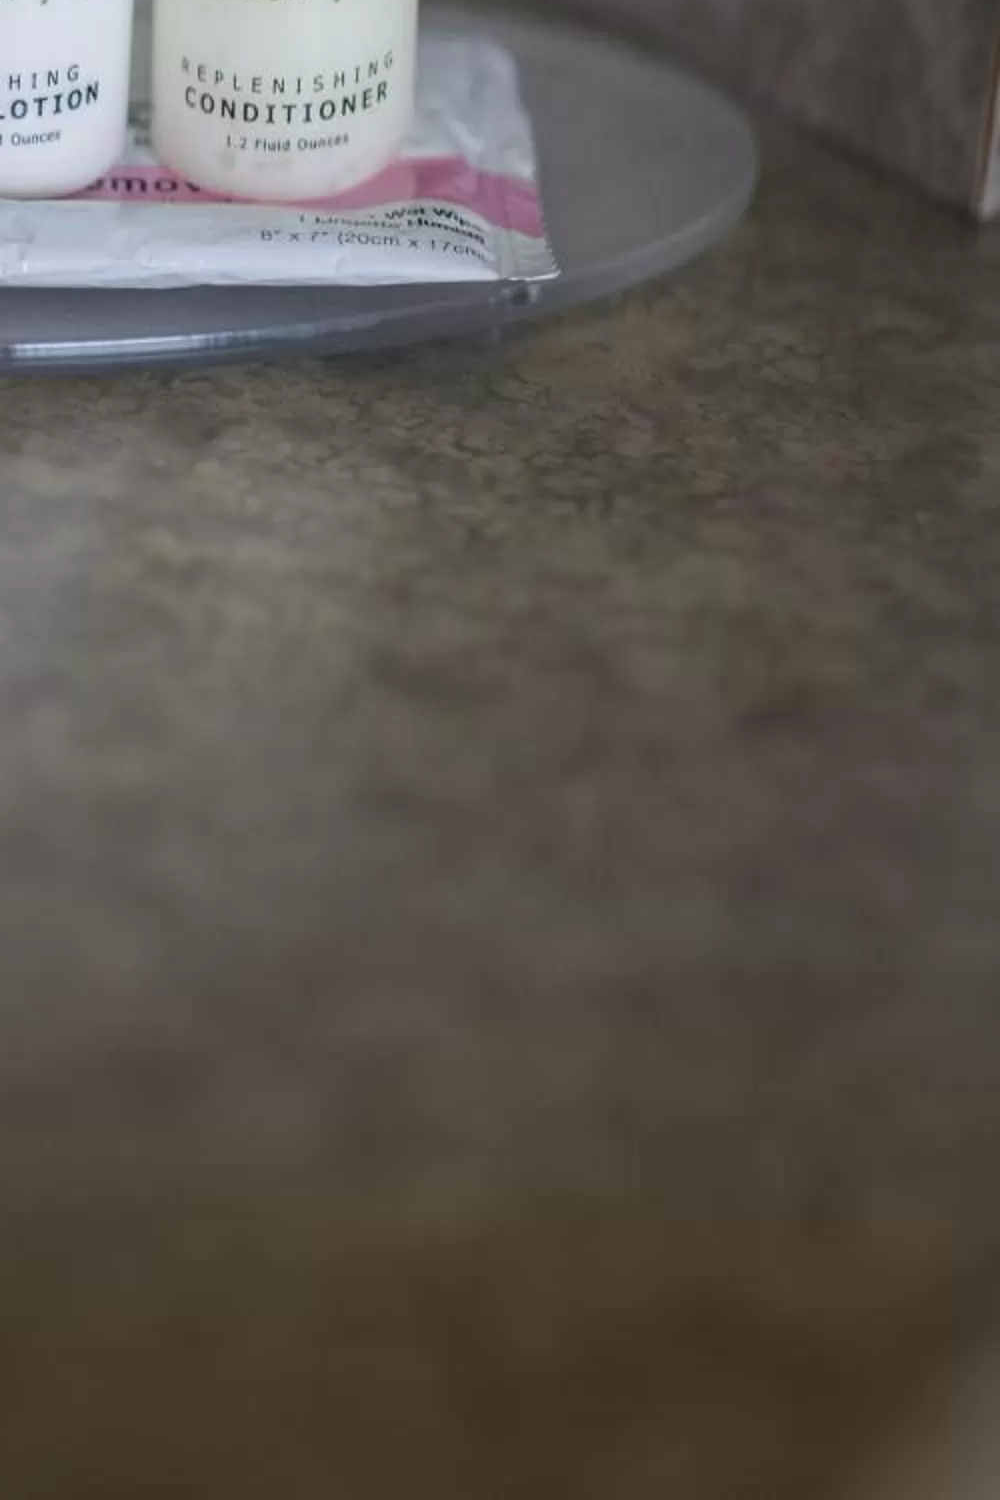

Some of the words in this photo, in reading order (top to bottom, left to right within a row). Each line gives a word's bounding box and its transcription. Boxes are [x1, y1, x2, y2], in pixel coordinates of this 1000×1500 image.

[181, 50, 394, 94] REPLENISHING
[184, 80, 388, 124] CONDITIONER
[11, 129, 61, 146] Ounces
[226, 134, 248, 150] 1.2
[255, 137, 291, 151] Fluid
[299, 133, 350, 151] Ounces
